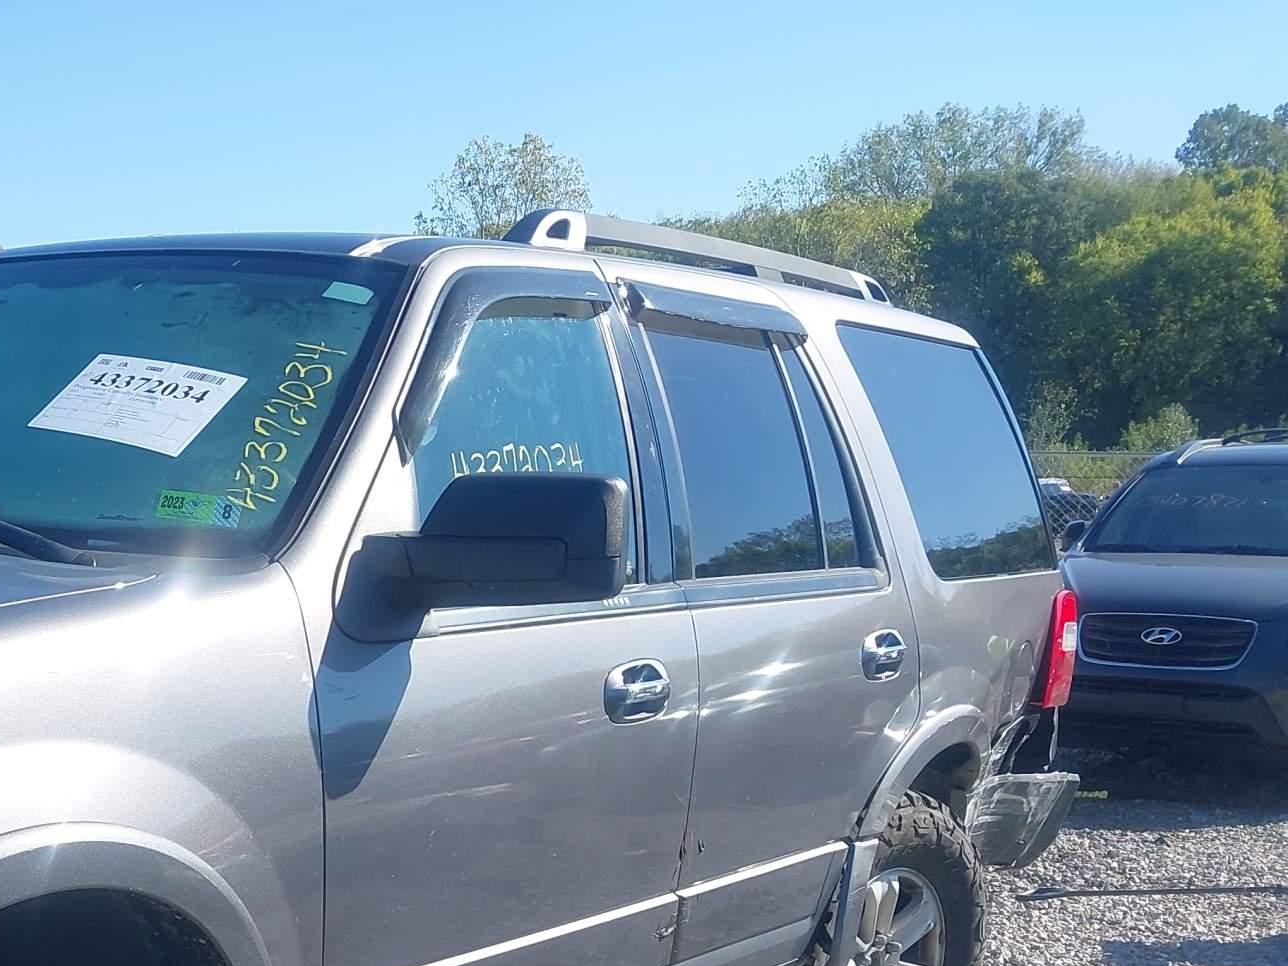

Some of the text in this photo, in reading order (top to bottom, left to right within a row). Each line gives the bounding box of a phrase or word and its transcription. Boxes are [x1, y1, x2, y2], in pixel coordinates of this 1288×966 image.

[89, 371, 211, 404] 43372034
[227, 341, 348, 510] 43372034
[160, 494, 186, 510] 2023
[222, 504, 233, 519] 8
